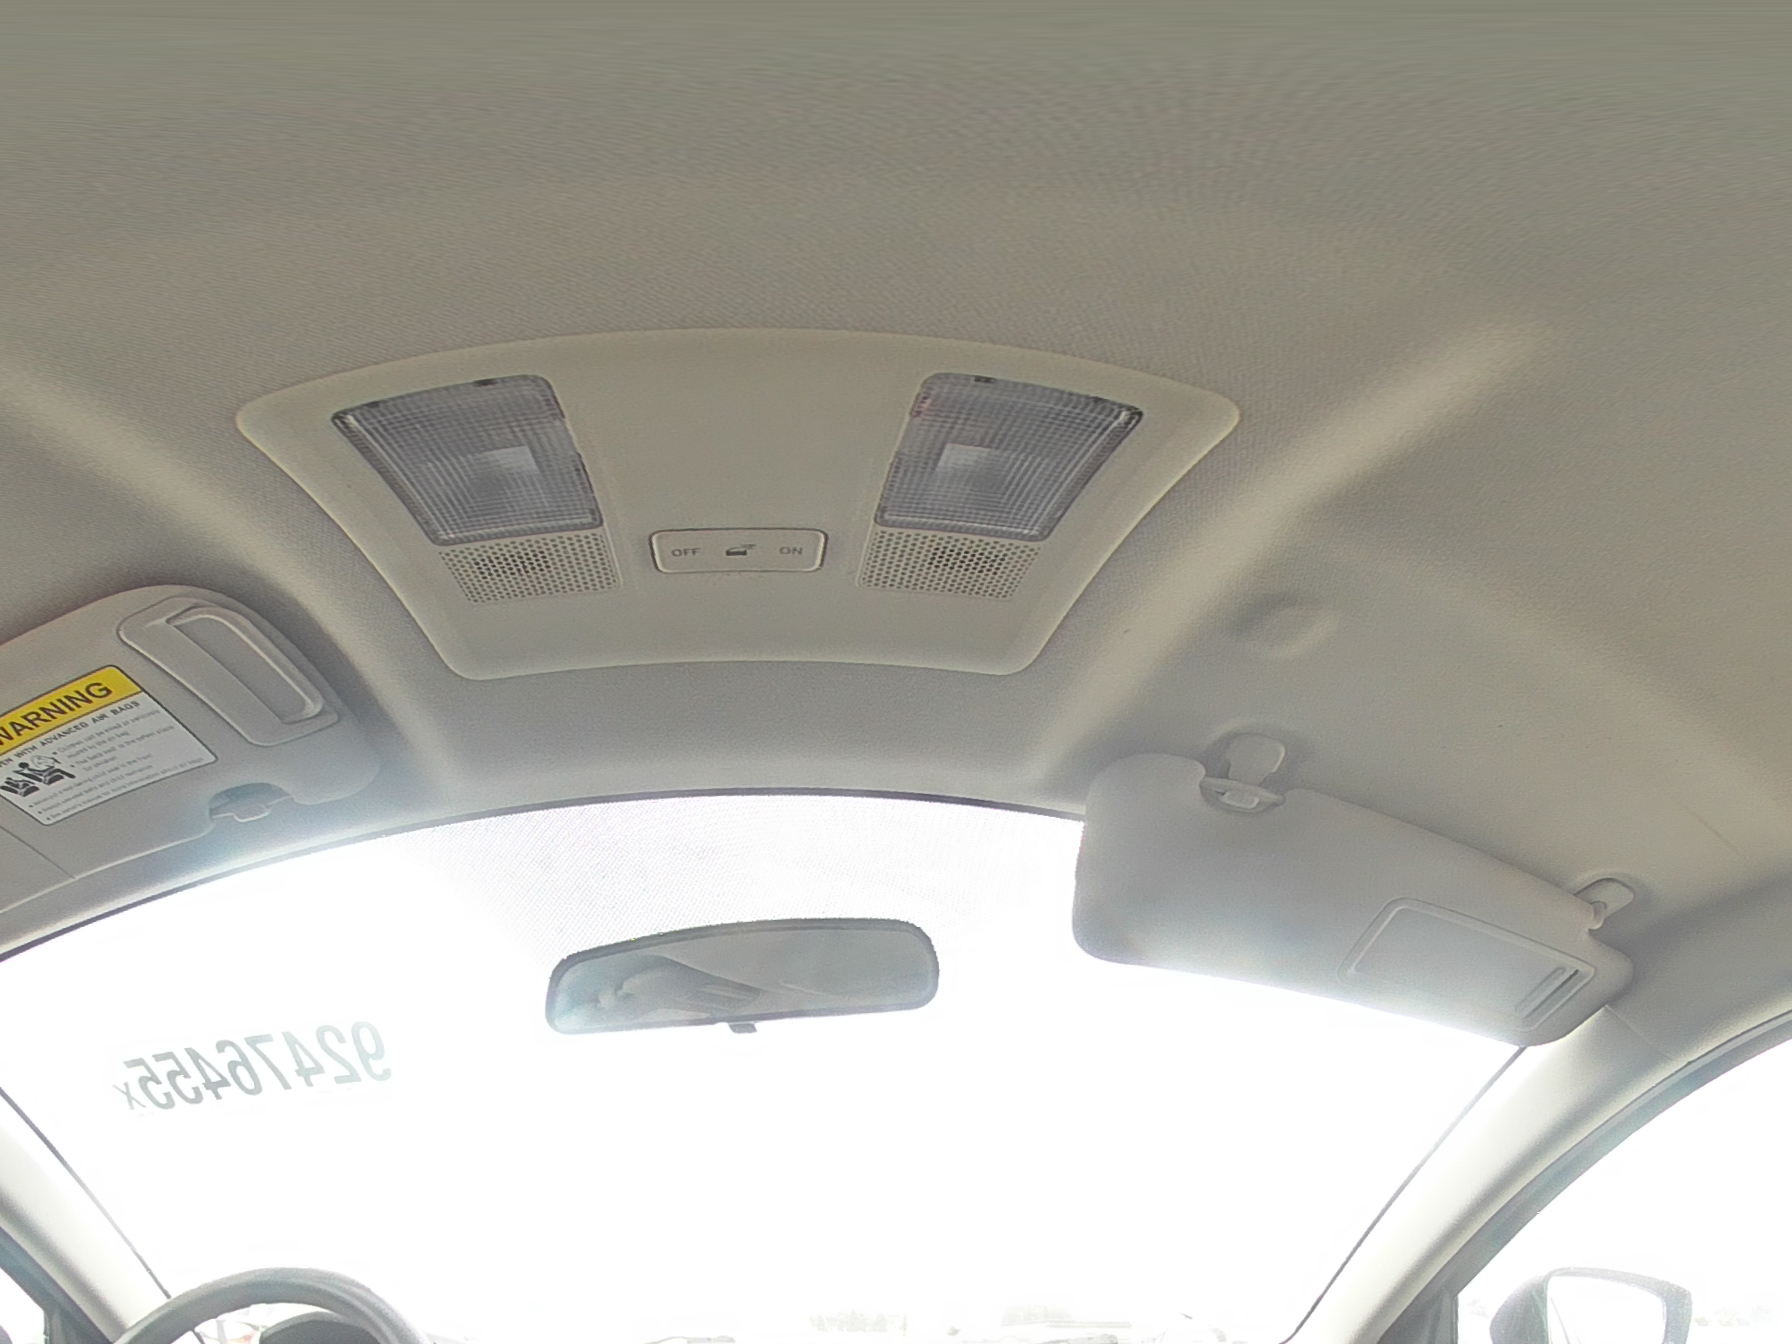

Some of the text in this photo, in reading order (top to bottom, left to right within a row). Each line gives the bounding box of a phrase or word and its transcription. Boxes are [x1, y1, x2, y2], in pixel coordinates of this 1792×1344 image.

[671, 547, 701, 557] OFF
[779, 546, 803, 555] ON
[14, 745, 37, 758] WITH
[39, 721, 89, 747] ADVANCED
[91, 713, 110, 724] AIR
[110, 701, 141, 715] BAGS
